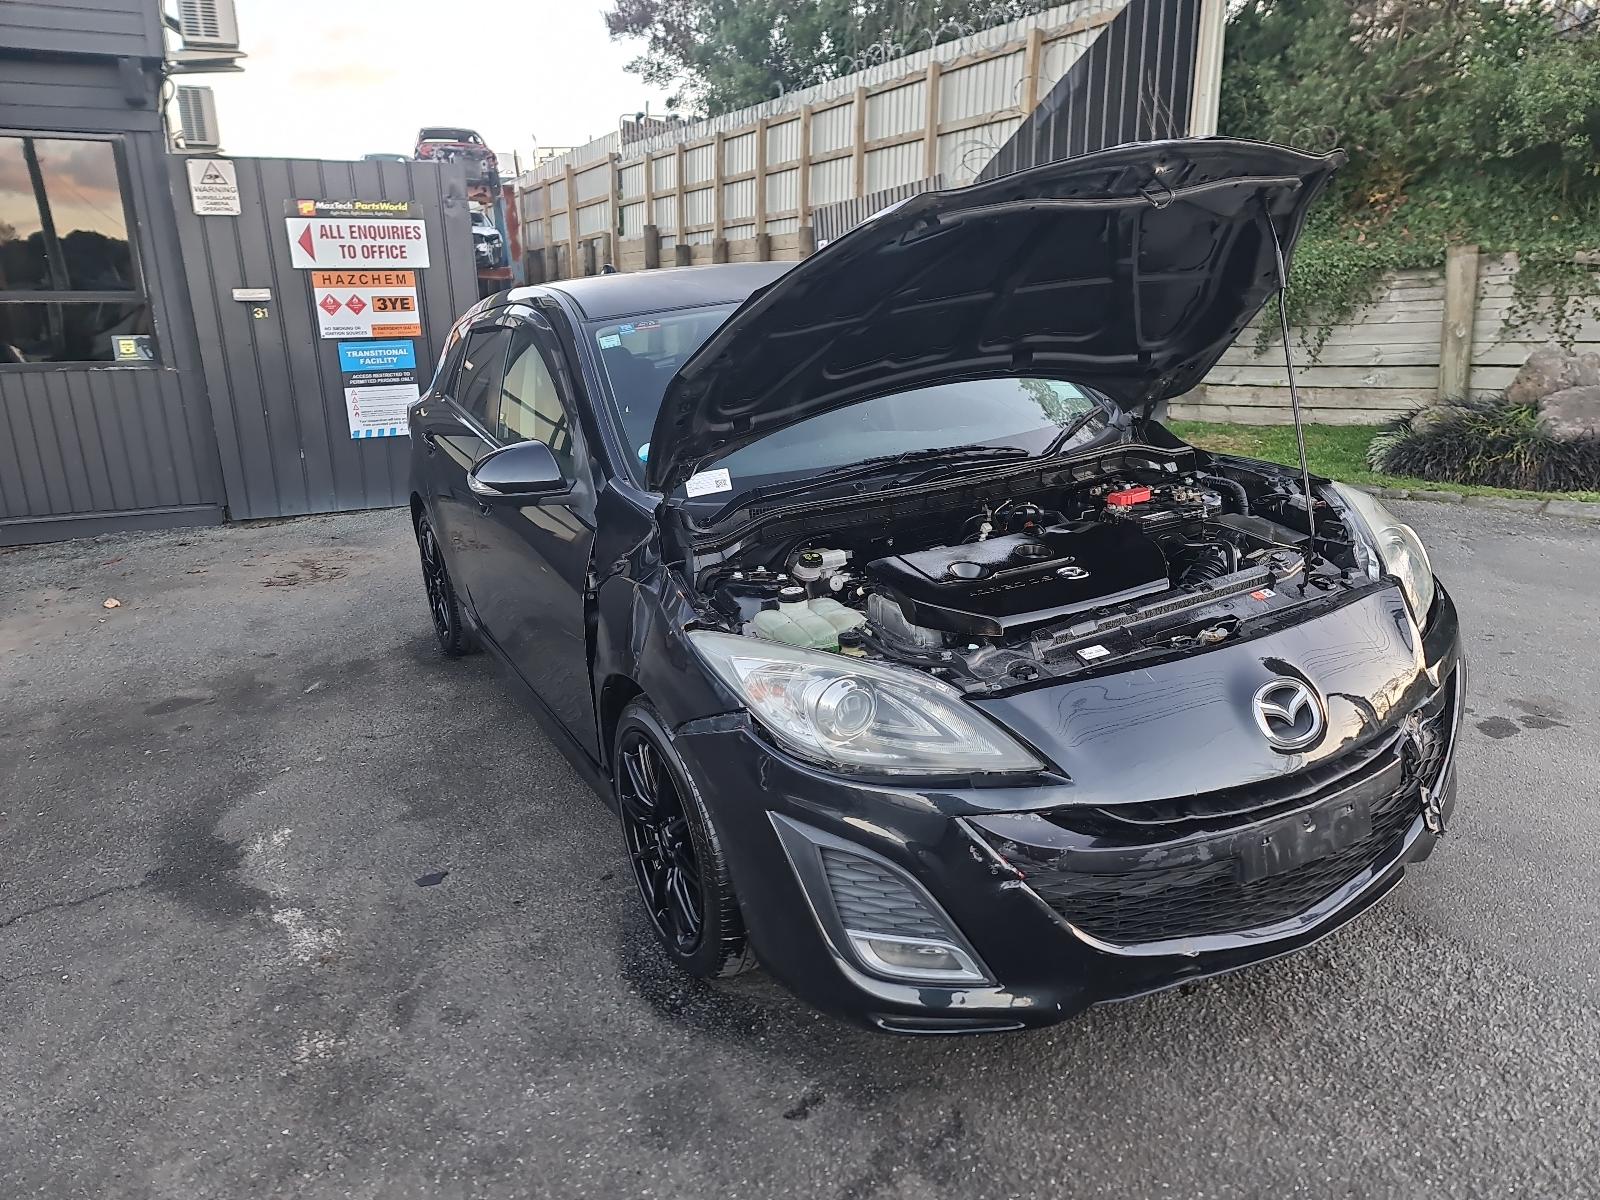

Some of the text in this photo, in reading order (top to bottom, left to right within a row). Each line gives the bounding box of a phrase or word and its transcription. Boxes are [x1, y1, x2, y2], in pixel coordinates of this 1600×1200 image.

[355, 202, 408, 210] PartsWorld
[320, 225, 422, 240] ALL ENQUIRIES
[339, 245, 408, 259] TO OFFICE
[322, 274, 406, 285] HAZCHEM
[376, 298, 410, 310] 3YE
[253, 308, 268, 318] 31
[346, 349, 408, 357] TRANSITIONAL
